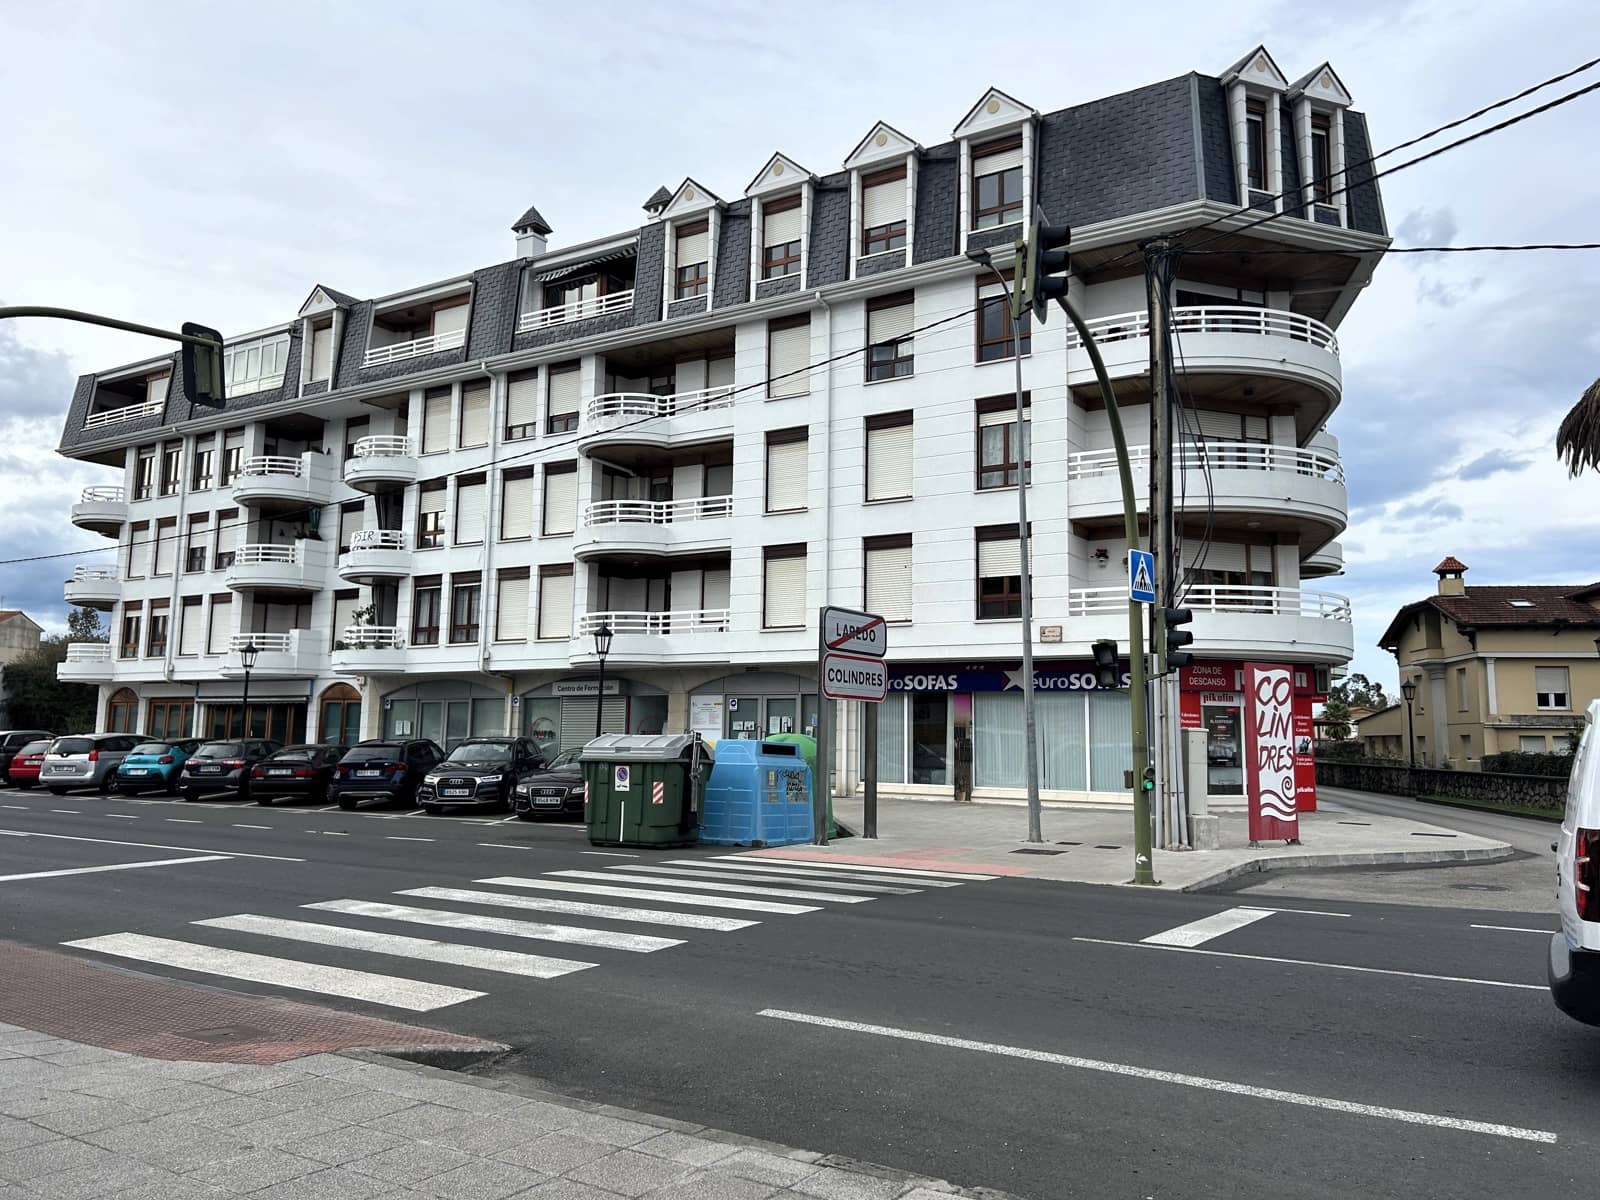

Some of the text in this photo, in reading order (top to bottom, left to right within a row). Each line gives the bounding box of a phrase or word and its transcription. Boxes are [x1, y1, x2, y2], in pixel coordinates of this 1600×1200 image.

[836, 622, 876, 642] LAREDO
[827, 667, 884, 687] COLINDRES
[1192, 665, 1223, 675] ZONA DE
[557, 685, 576, 693] Centro
[576, 684, 584, 692] de
[887, 675, 958, 690] roSOFAS
[1189, 676, 1227, 686] DESCANSO
[1255, 675, 1291, 707] CO
[1258, 744, 1294, 773] DRES
